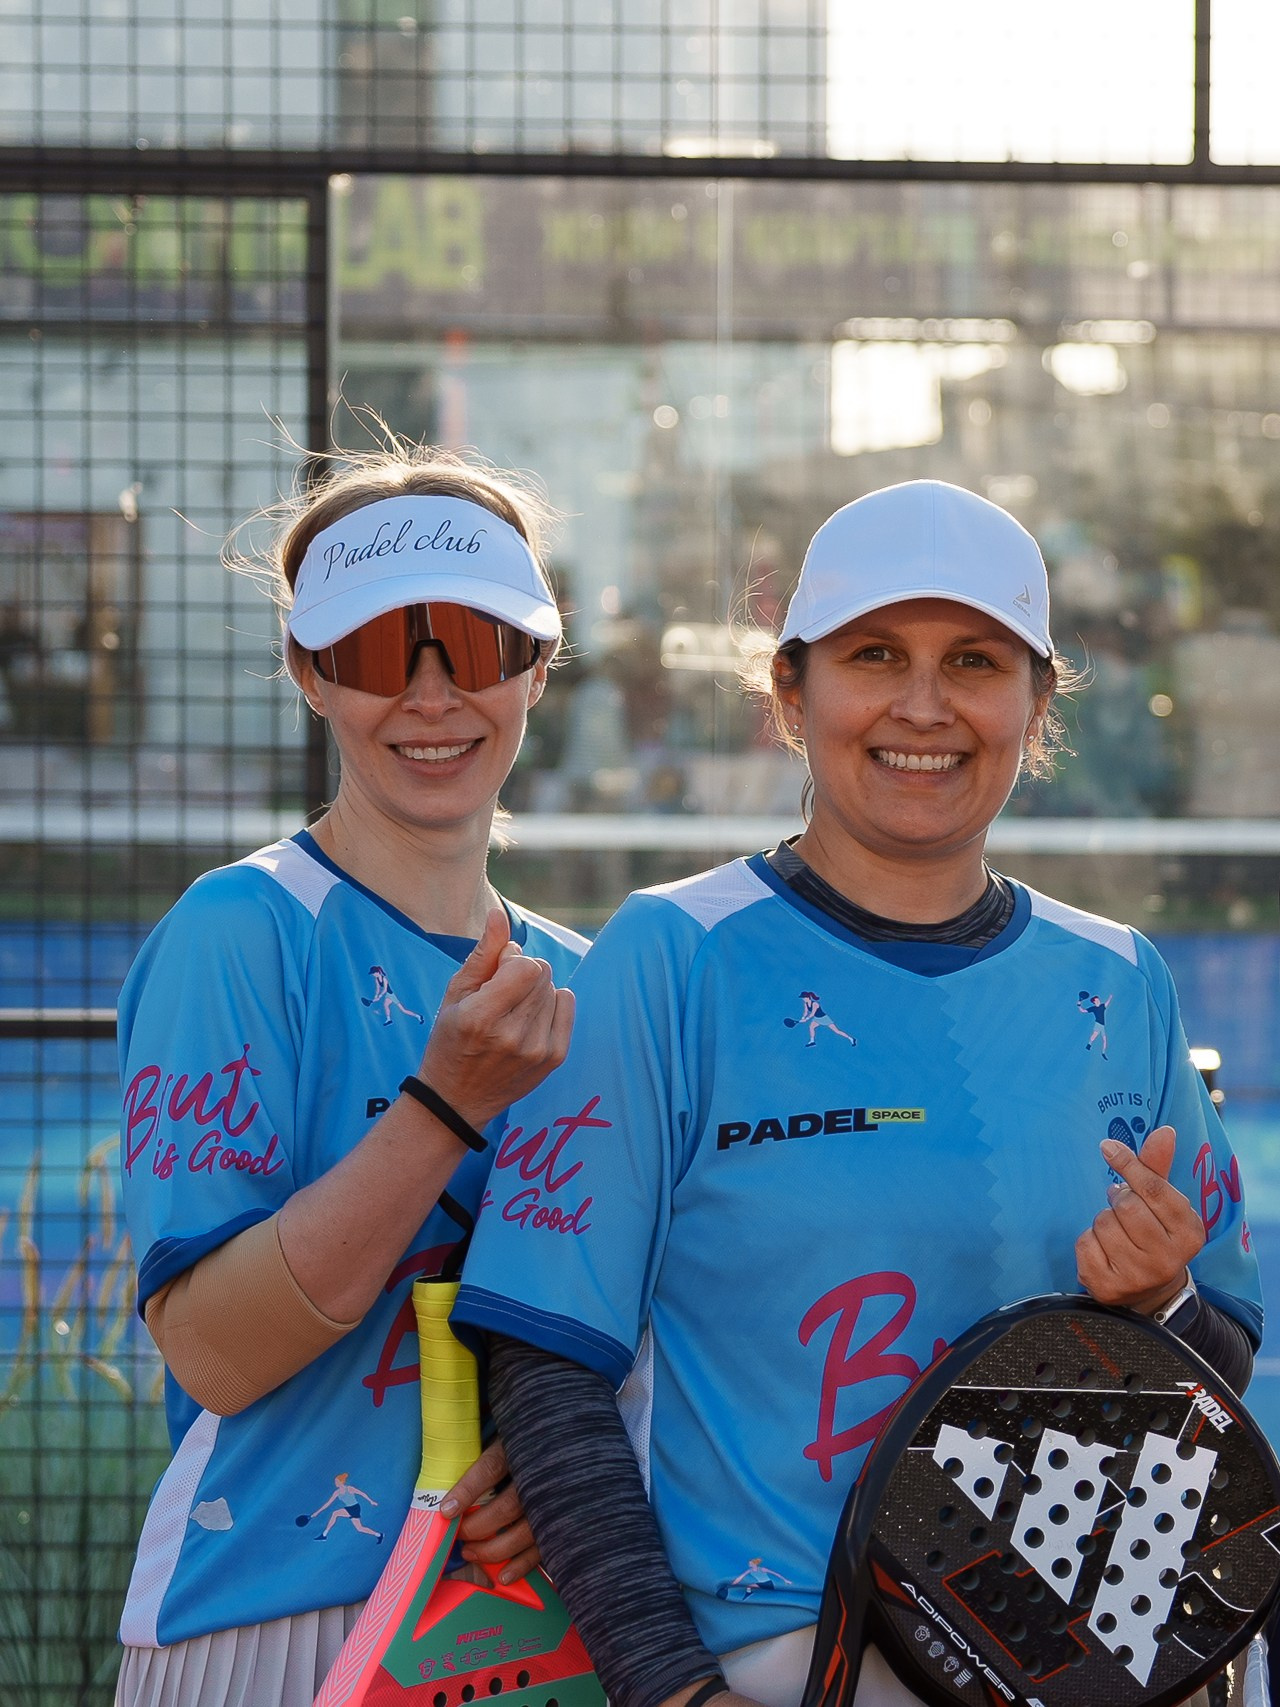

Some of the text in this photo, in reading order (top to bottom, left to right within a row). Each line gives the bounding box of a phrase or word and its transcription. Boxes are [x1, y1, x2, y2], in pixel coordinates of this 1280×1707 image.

[323, 519, 488, 583] Padel club
[1097, 1092, 1124, 1114] BRUT
[1128, 1093, 1143, 1107] IS
[716, 1107, 921, 1151] PADEL SPACE
[152, 1129, 285, 1180] is Good
[502, 1187, 593, 1236] Good
[900, 1581, 1016, 1702] ADIPOWER
